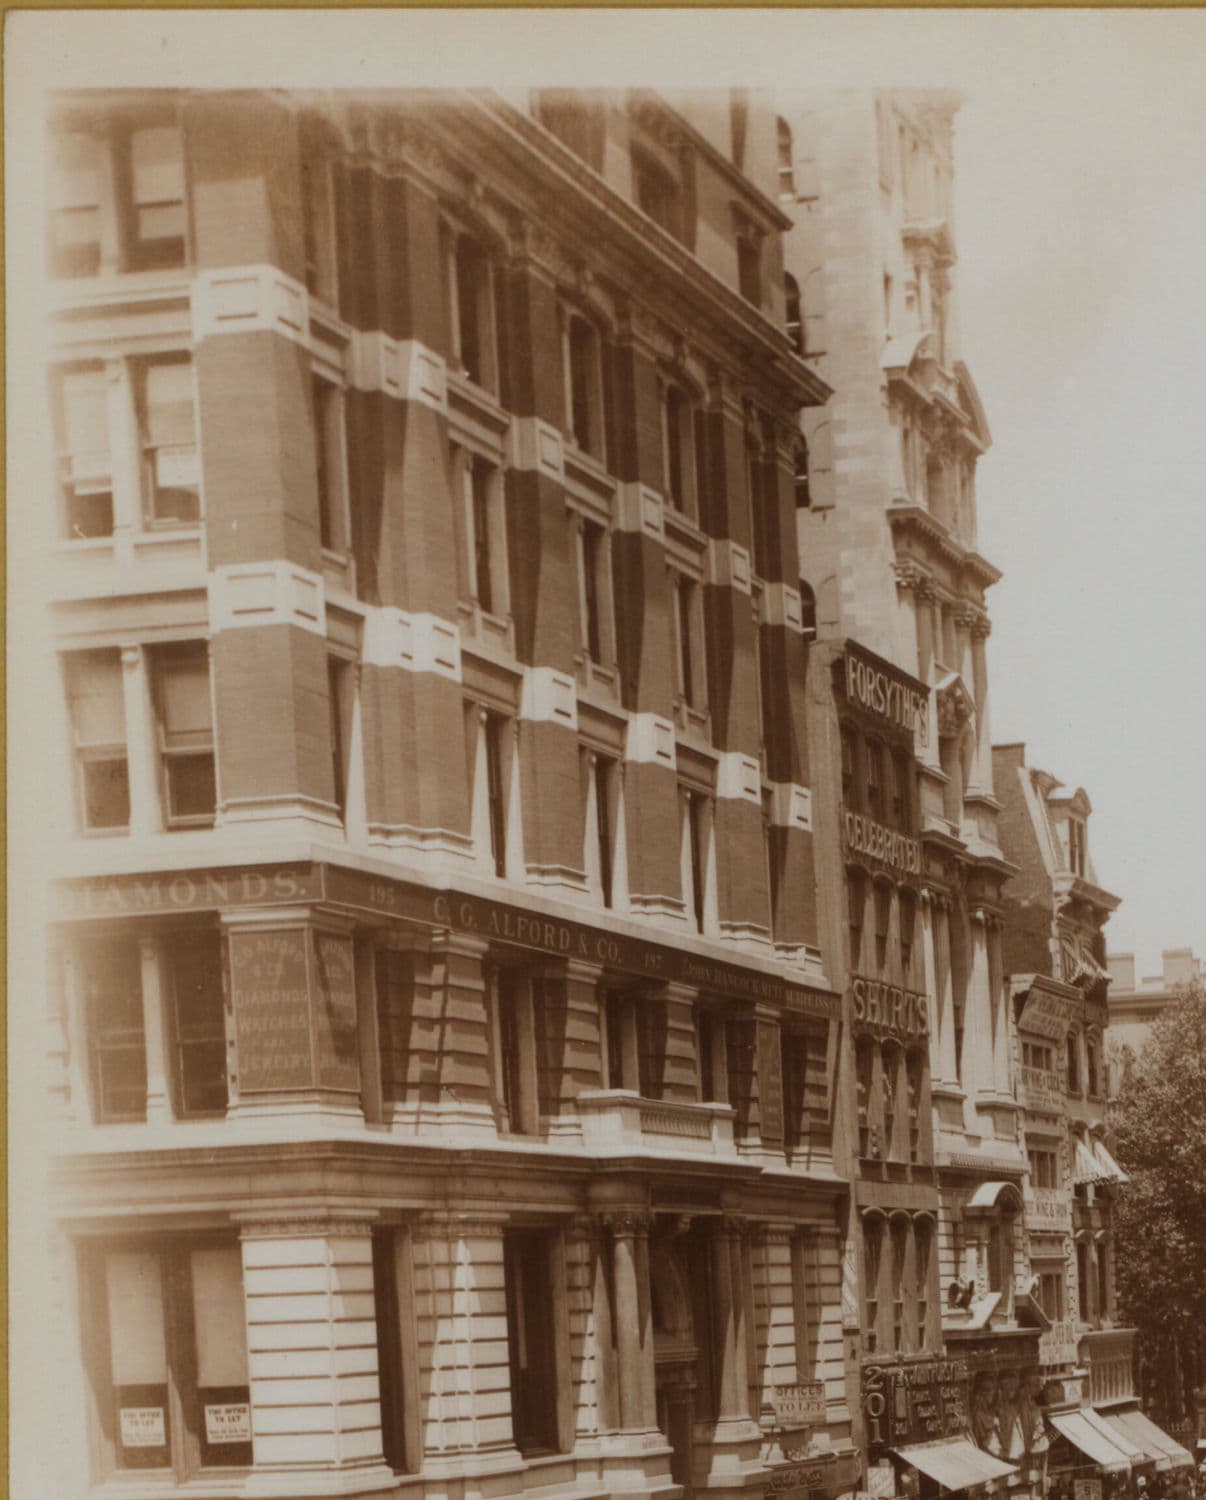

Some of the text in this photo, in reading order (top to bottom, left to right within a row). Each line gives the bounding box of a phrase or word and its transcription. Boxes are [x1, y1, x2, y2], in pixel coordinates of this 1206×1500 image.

[845, 811, 920, 875] CELEBRATED
[489, 910, 570, 950] ALFORD
[579, 934, 588, 954] &
[596, 937, 622, 964] CO.
[853, 978, 928, 1036] SHIRTS
[776, 1387, 822, 1398] OFFICES
[777, 1401, 824, 1413] TO LET
[864, 1366, 885, 1443] 201
